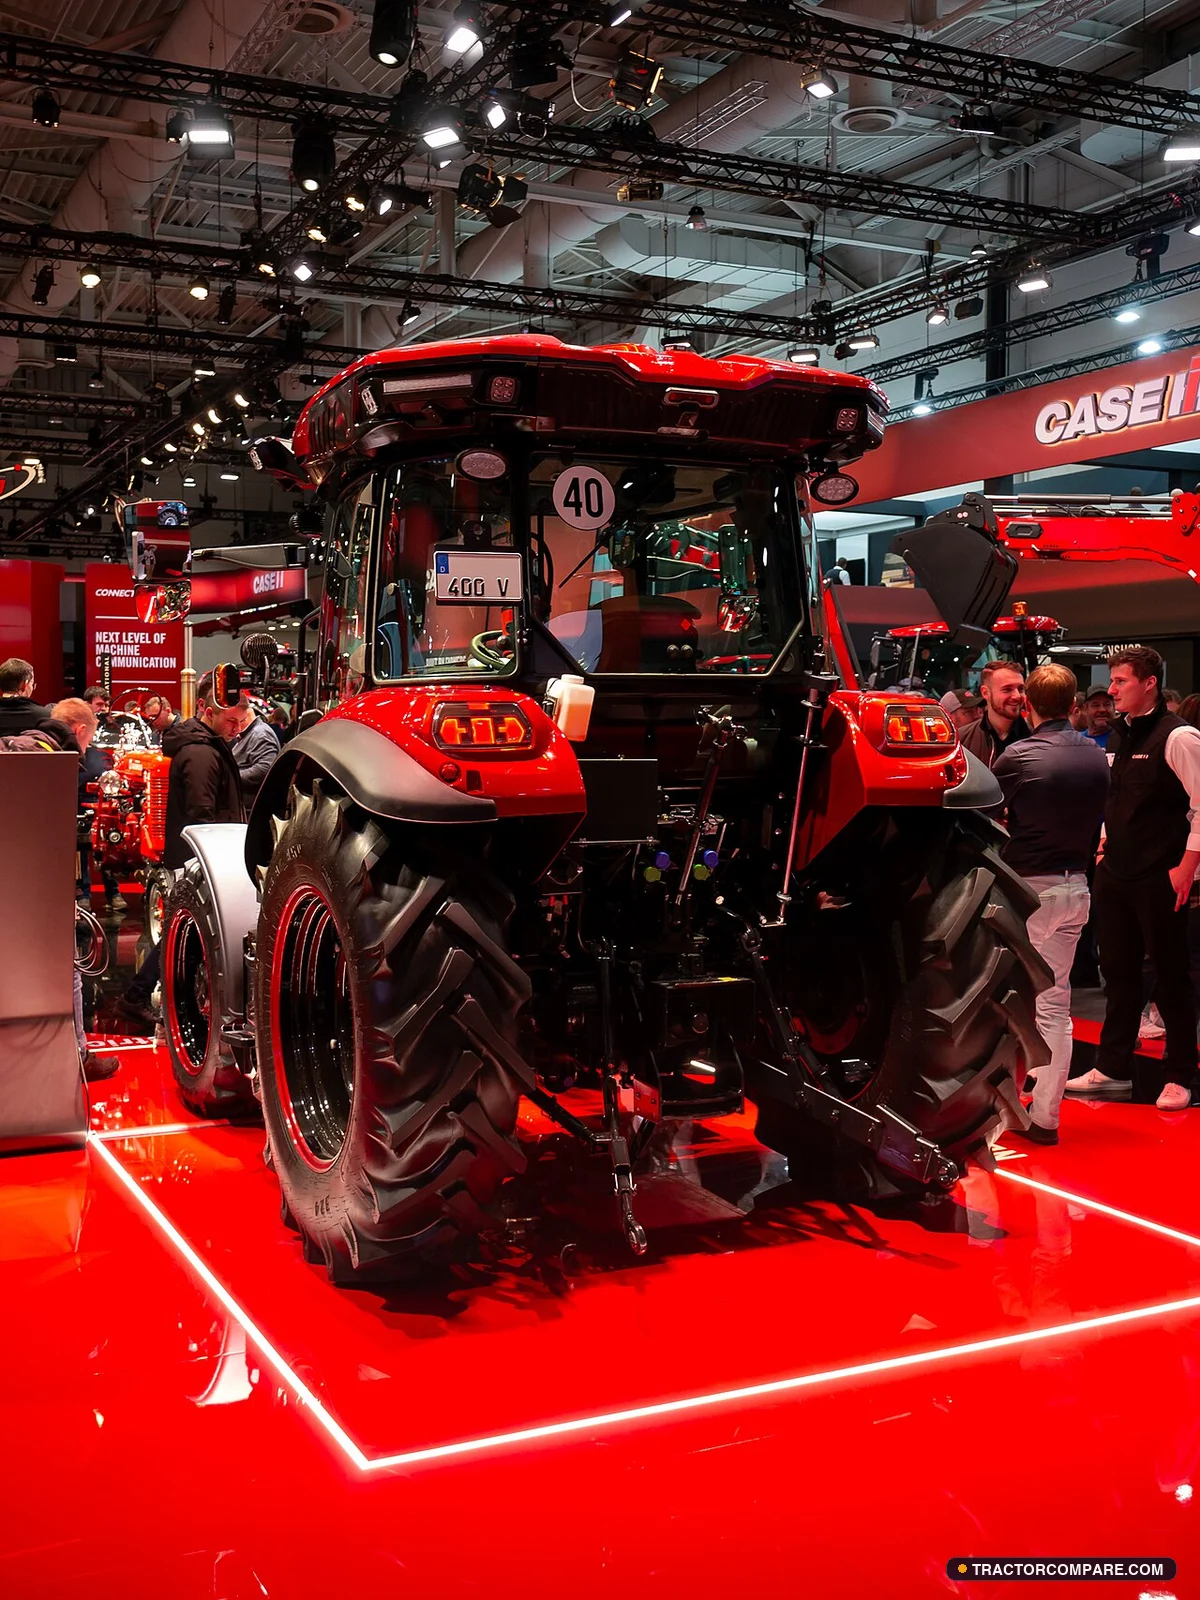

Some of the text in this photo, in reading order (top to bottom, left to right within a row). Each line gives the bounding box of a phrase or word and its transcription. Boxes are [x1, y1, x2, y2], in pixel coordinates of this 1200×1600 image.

[1034, 375, 1170, 445] CASE
[563, 476, 604, 519] 40
[253, 571, 276, 595] CASE
[447, 576, 485, 597] 400
[496, 577, 509, 597] V
[95, 631, 167, 644] NEXT LEVEL OF
[95, 644, 140, 656] MACHINE
[95, 656, 177, 668] CMMUNICATION
